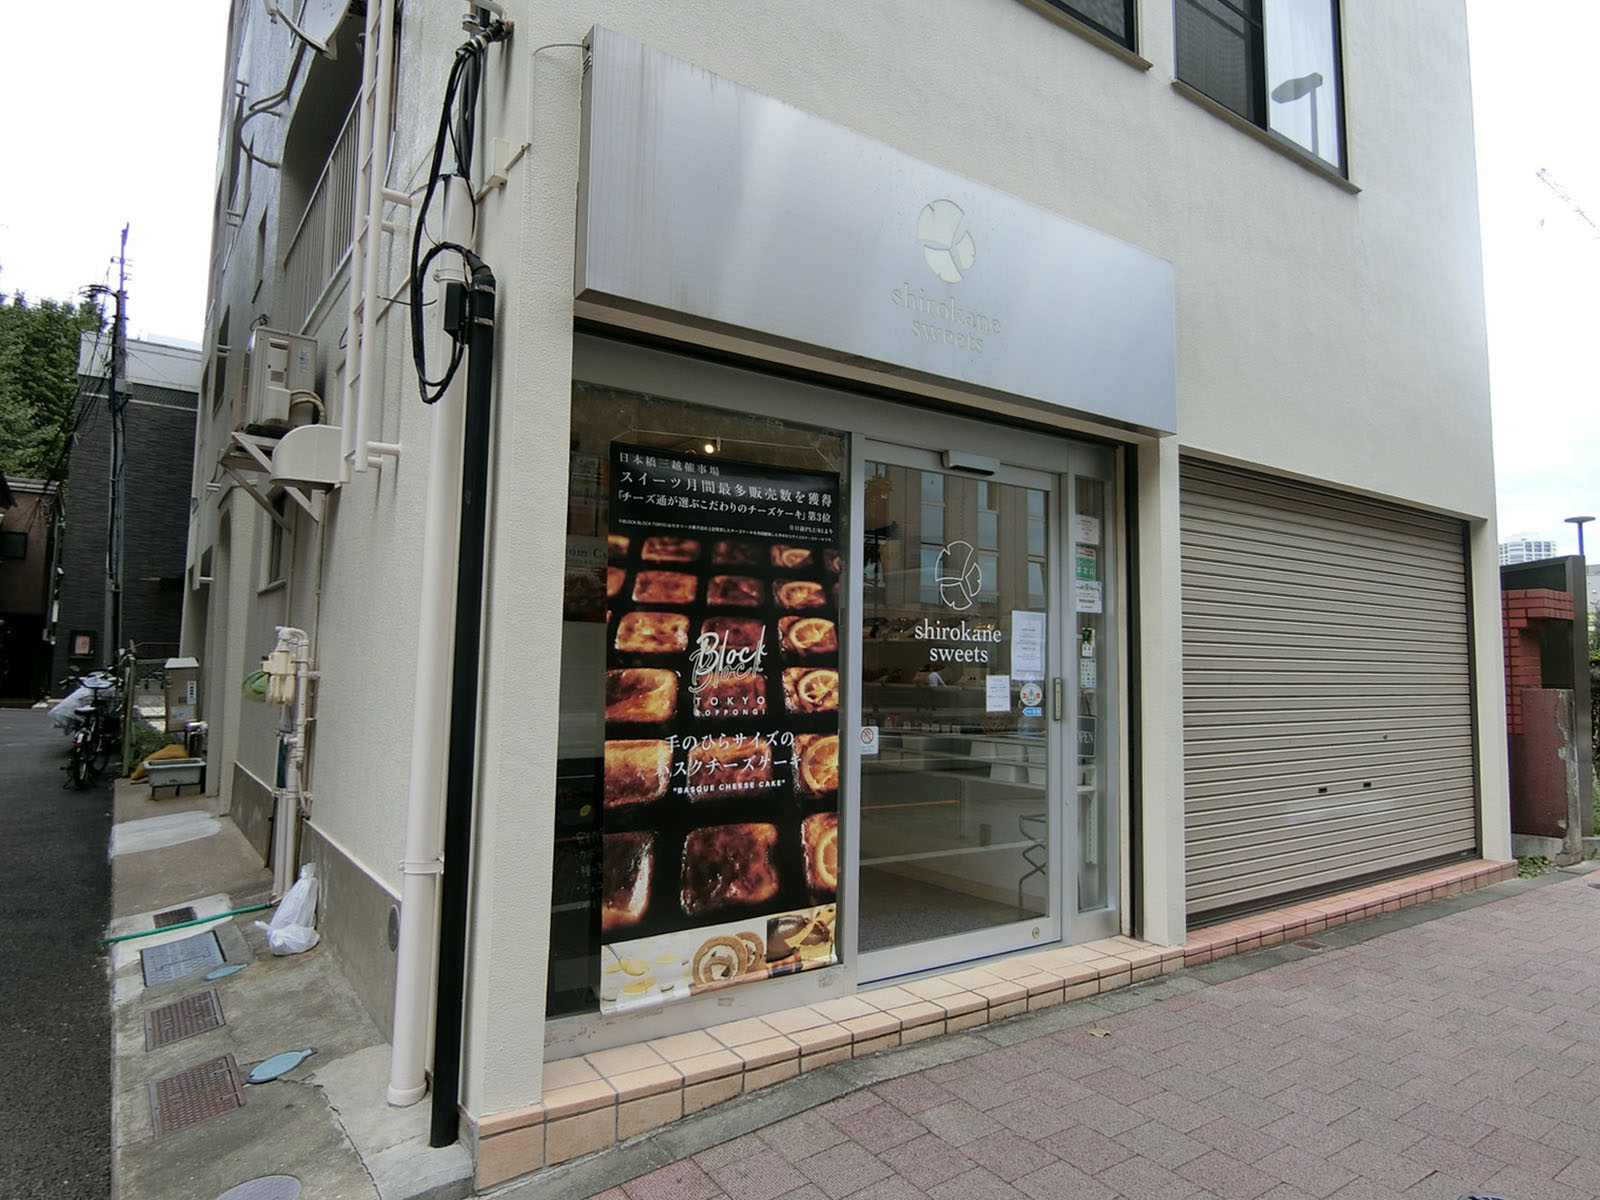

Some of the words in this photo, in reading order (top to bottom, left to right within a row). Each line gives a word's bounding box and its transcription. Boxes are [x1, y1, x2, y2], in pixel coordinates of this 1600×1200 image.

[891, 281, 1001, 334] shirokane
[911, 320, 985, 354] sweets
[619, 452, 720, 477] 日本橋三越催事場
[620, 471, 833, 508] スイーツ月間最多販売数を獲得
[914, 618, 1002, 643] shirokane
[696, 625, 768, 675] Block
[929, 646, 989, 663] sweets
[695, 696, 766, 706] TOKYO
[665, 729, 796, 753] 手のひらサイズの
[718, 781, 755, 791] CHEESE
